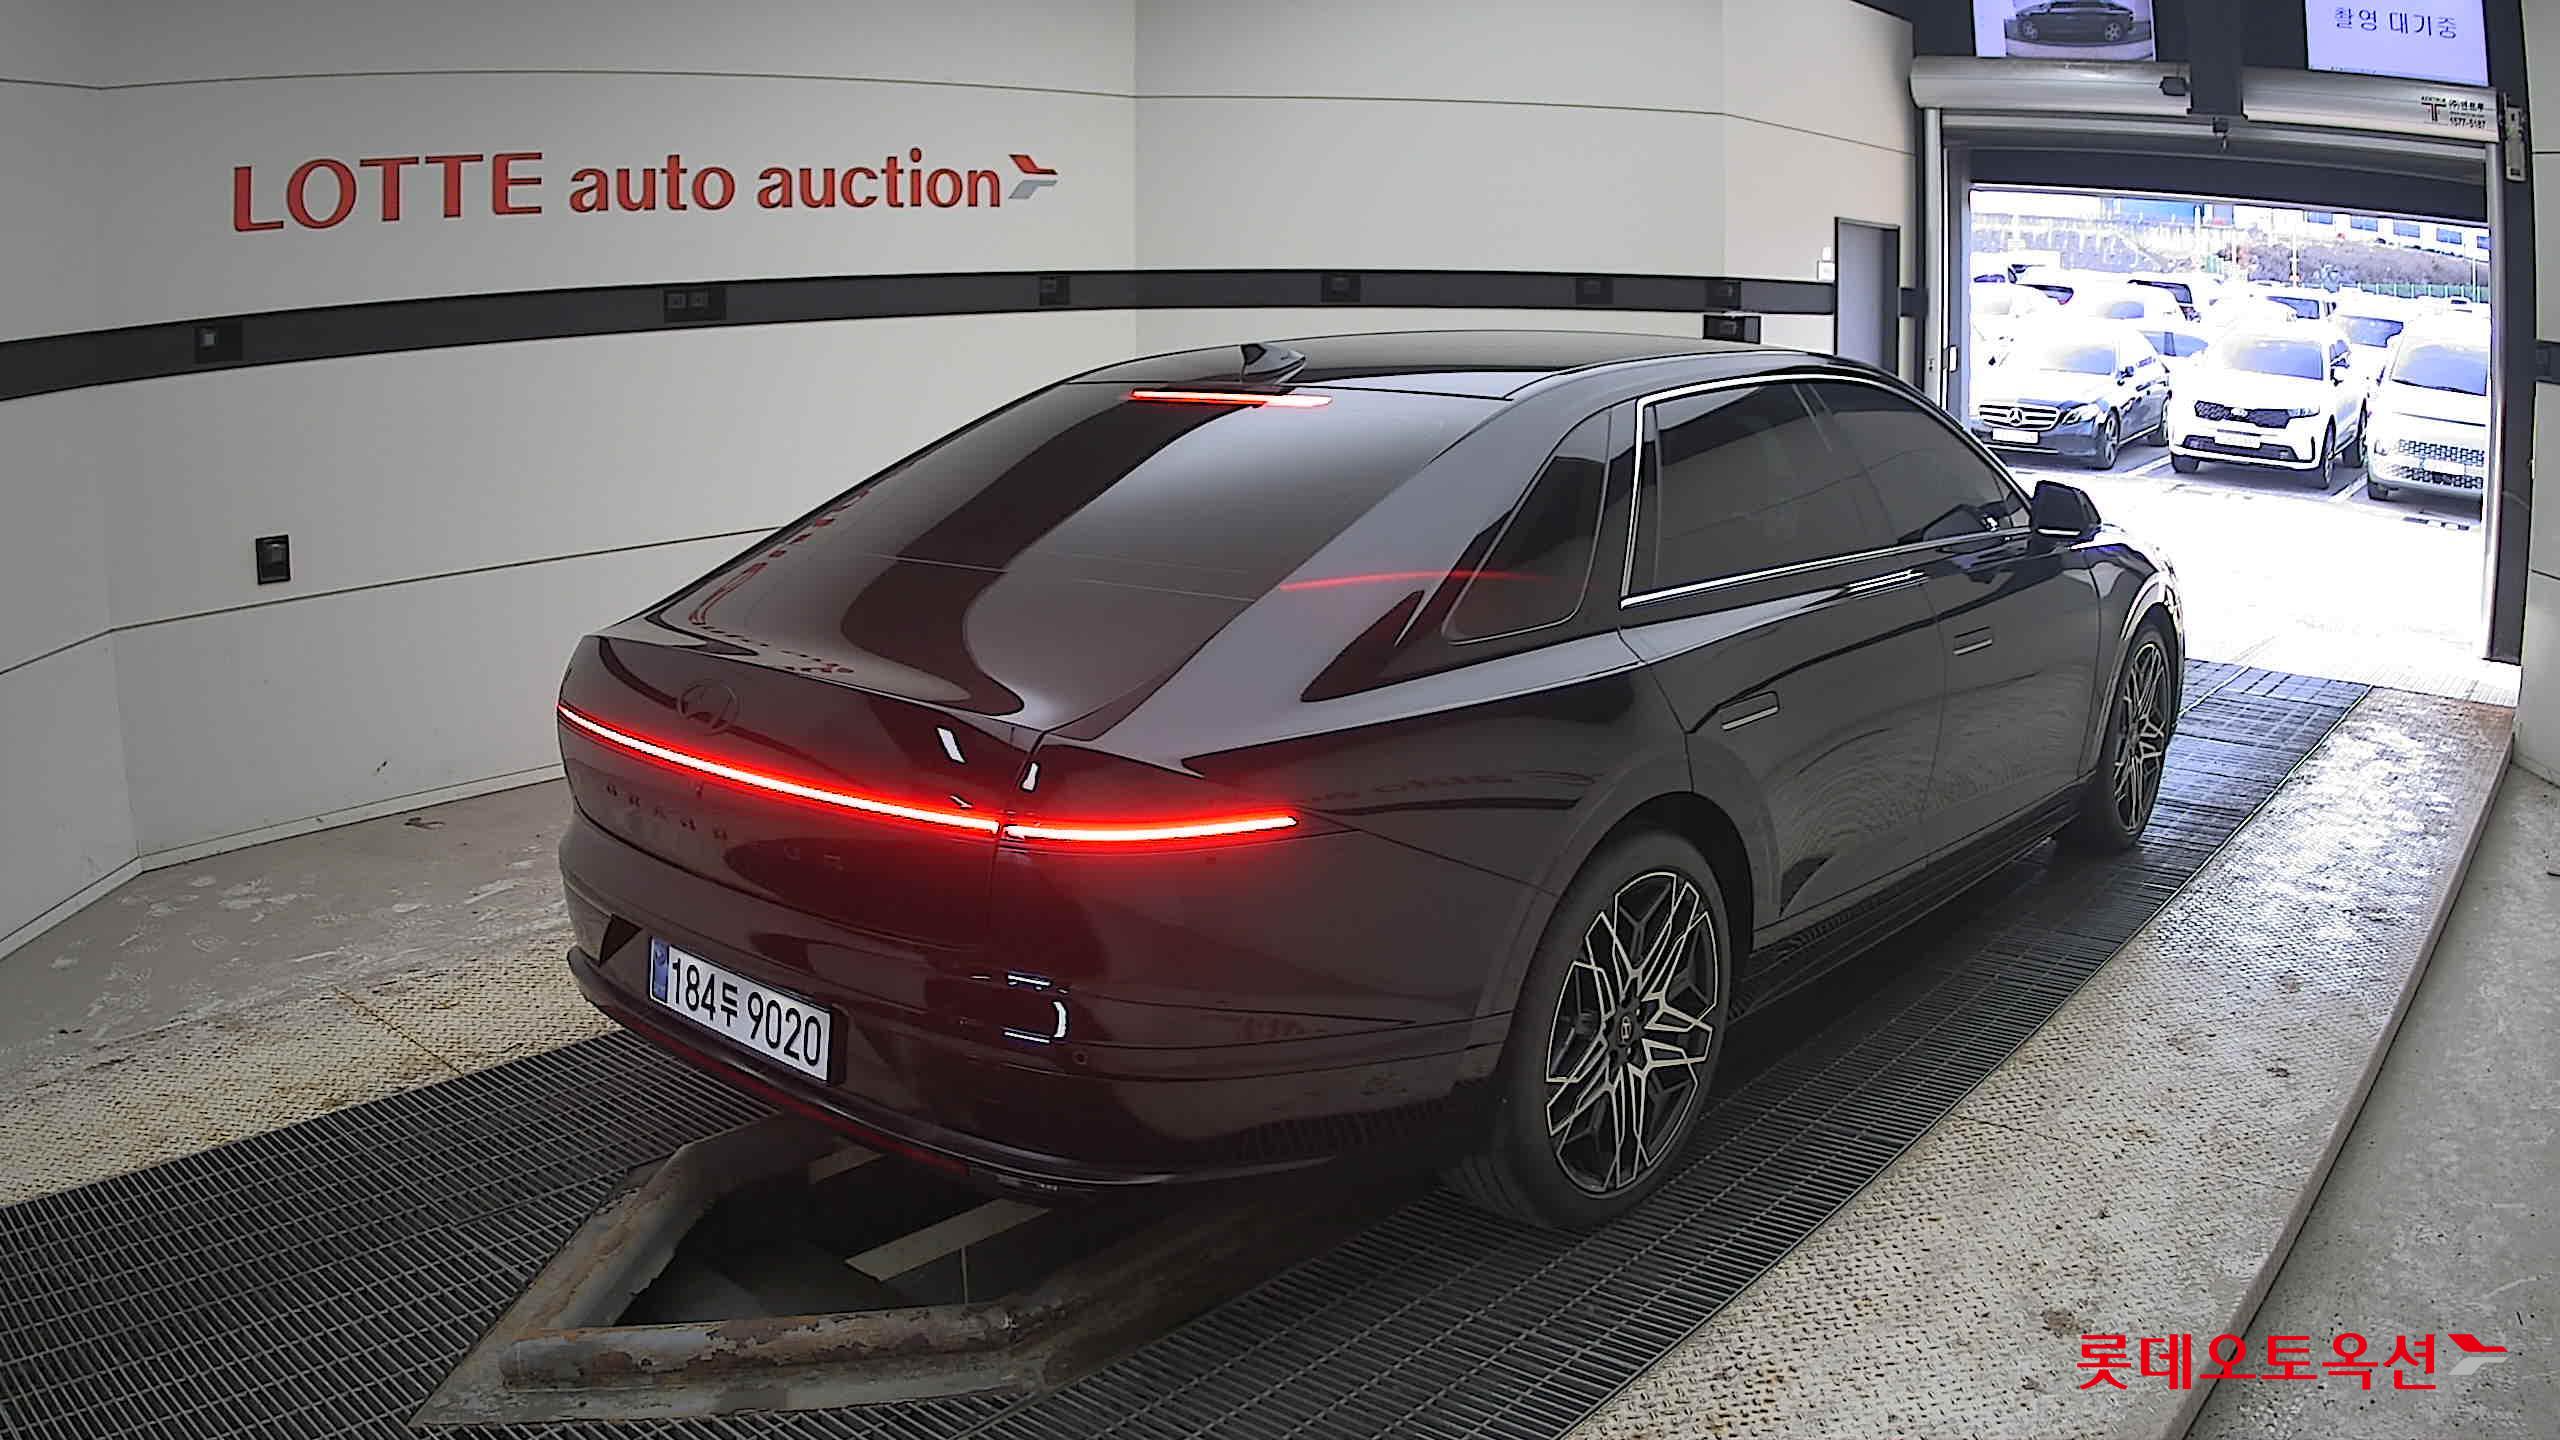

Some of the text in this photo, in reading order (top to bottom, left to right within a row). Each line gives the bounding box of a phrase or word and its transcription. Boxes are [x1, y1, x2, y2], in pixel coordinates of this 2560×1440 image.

[2389, 12, 2457, 40] 대기중
[233, 147, 1001, 232] LOTTE auto auction
[672, 957, 822, 1067] 184두 9020
